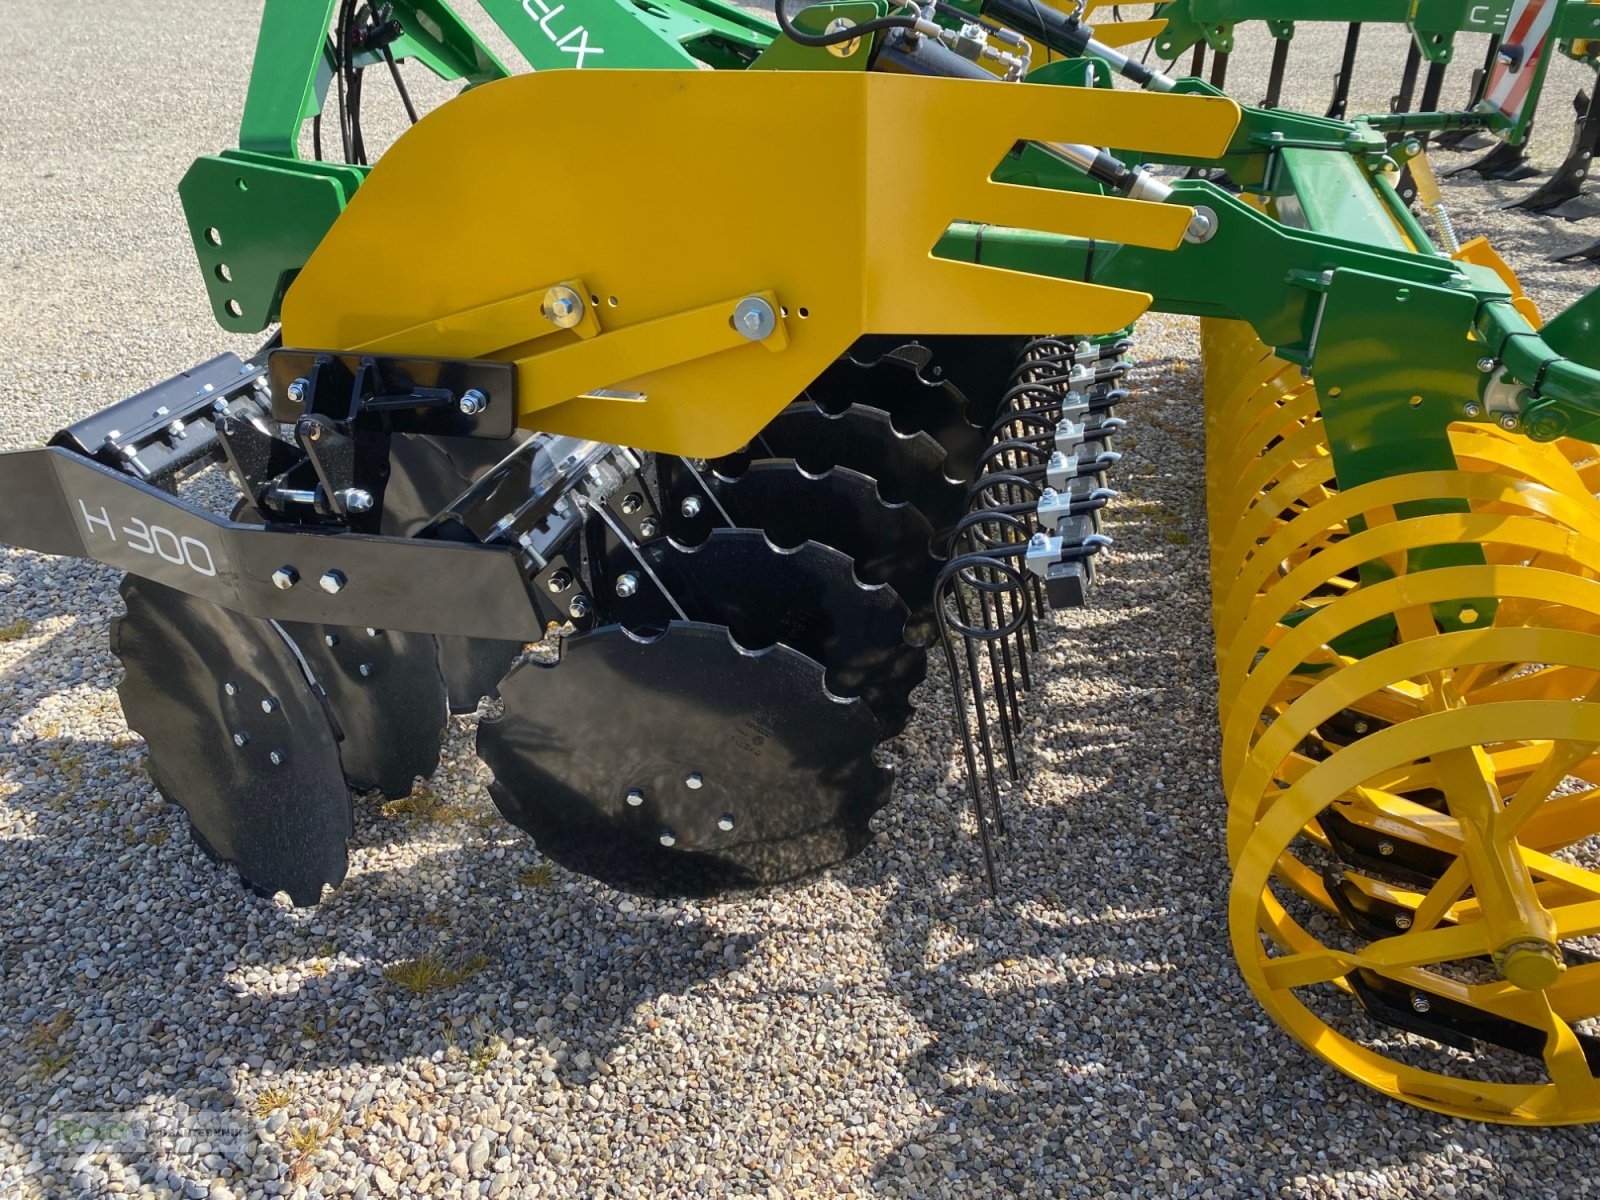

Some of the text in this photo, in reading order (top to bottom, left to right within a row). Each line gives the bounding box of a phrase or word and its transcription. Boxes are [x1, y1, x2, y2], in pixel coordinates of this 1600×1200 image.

[521, 0, 604, 69] ELIX
[78, 499, 217, 577] H 300
